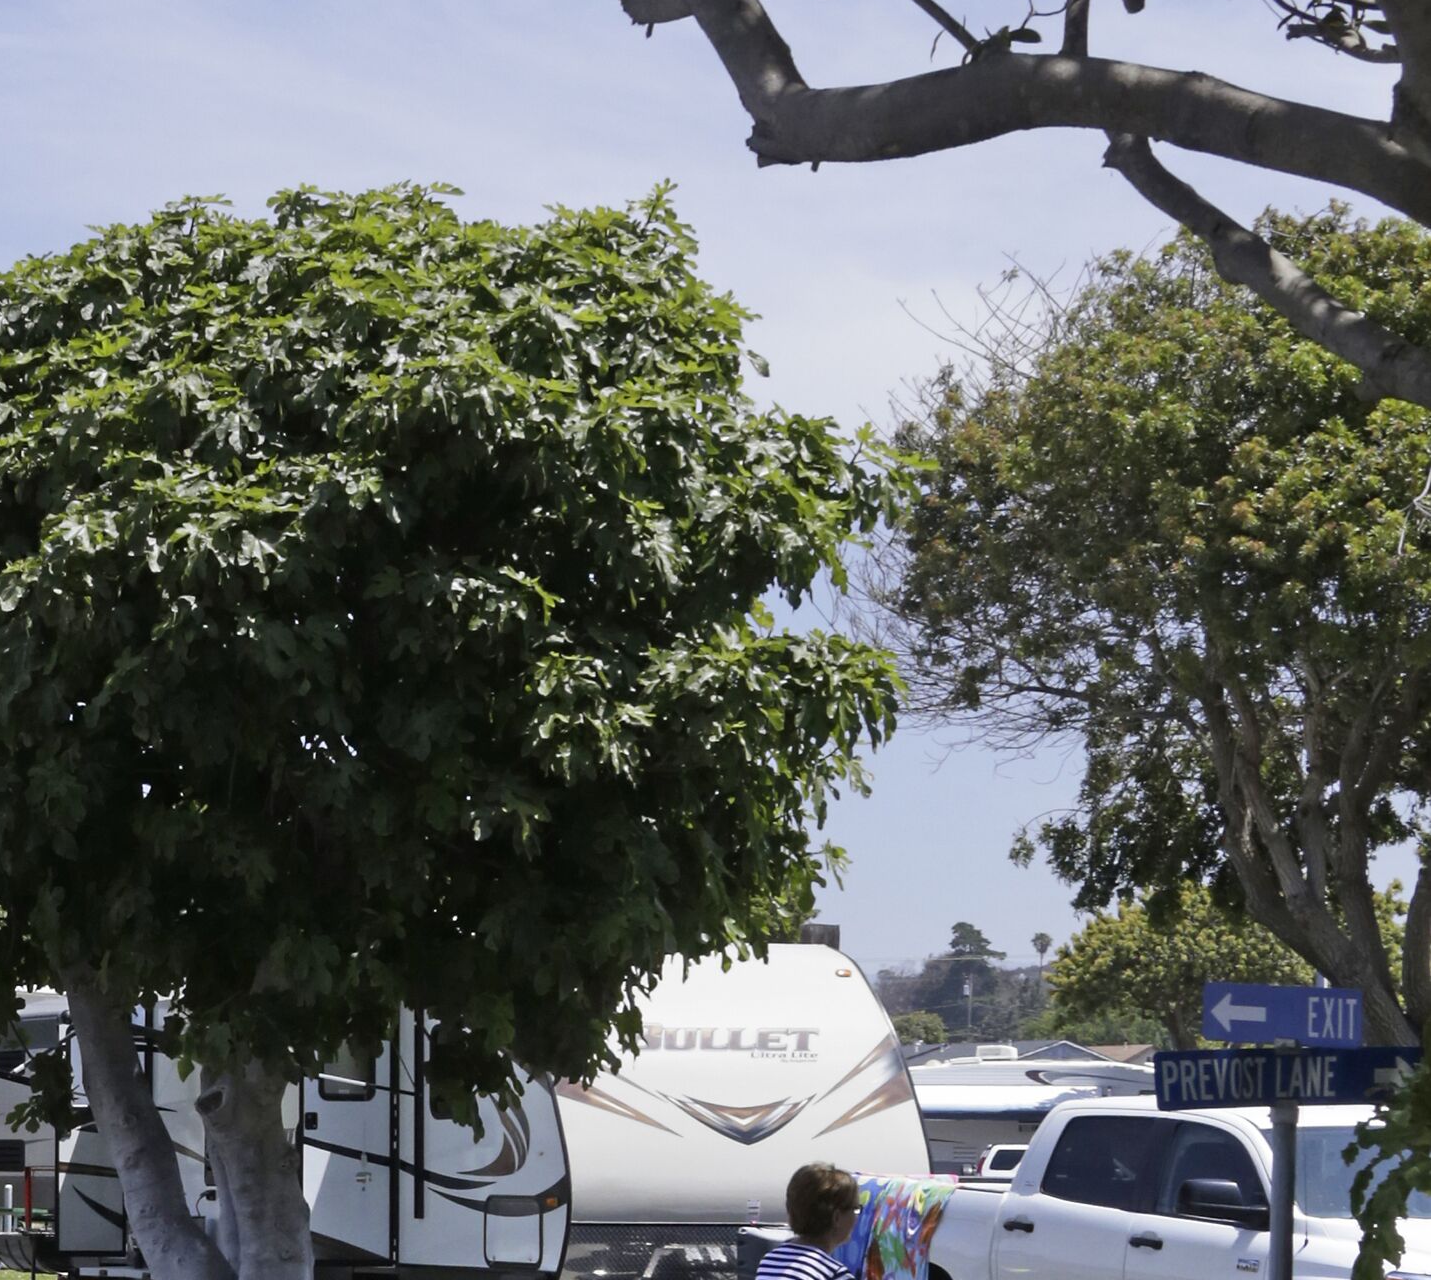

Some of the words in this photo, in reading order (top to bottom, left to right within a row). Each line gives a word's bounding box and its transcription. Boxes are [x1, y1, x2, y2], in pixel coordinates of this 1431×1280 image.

[1307, 996, 1358, 1040] EXIT
[1161, 1057, 1267, 1102] PREVOST
[1275, 1056, 1338, 1098] LANE
